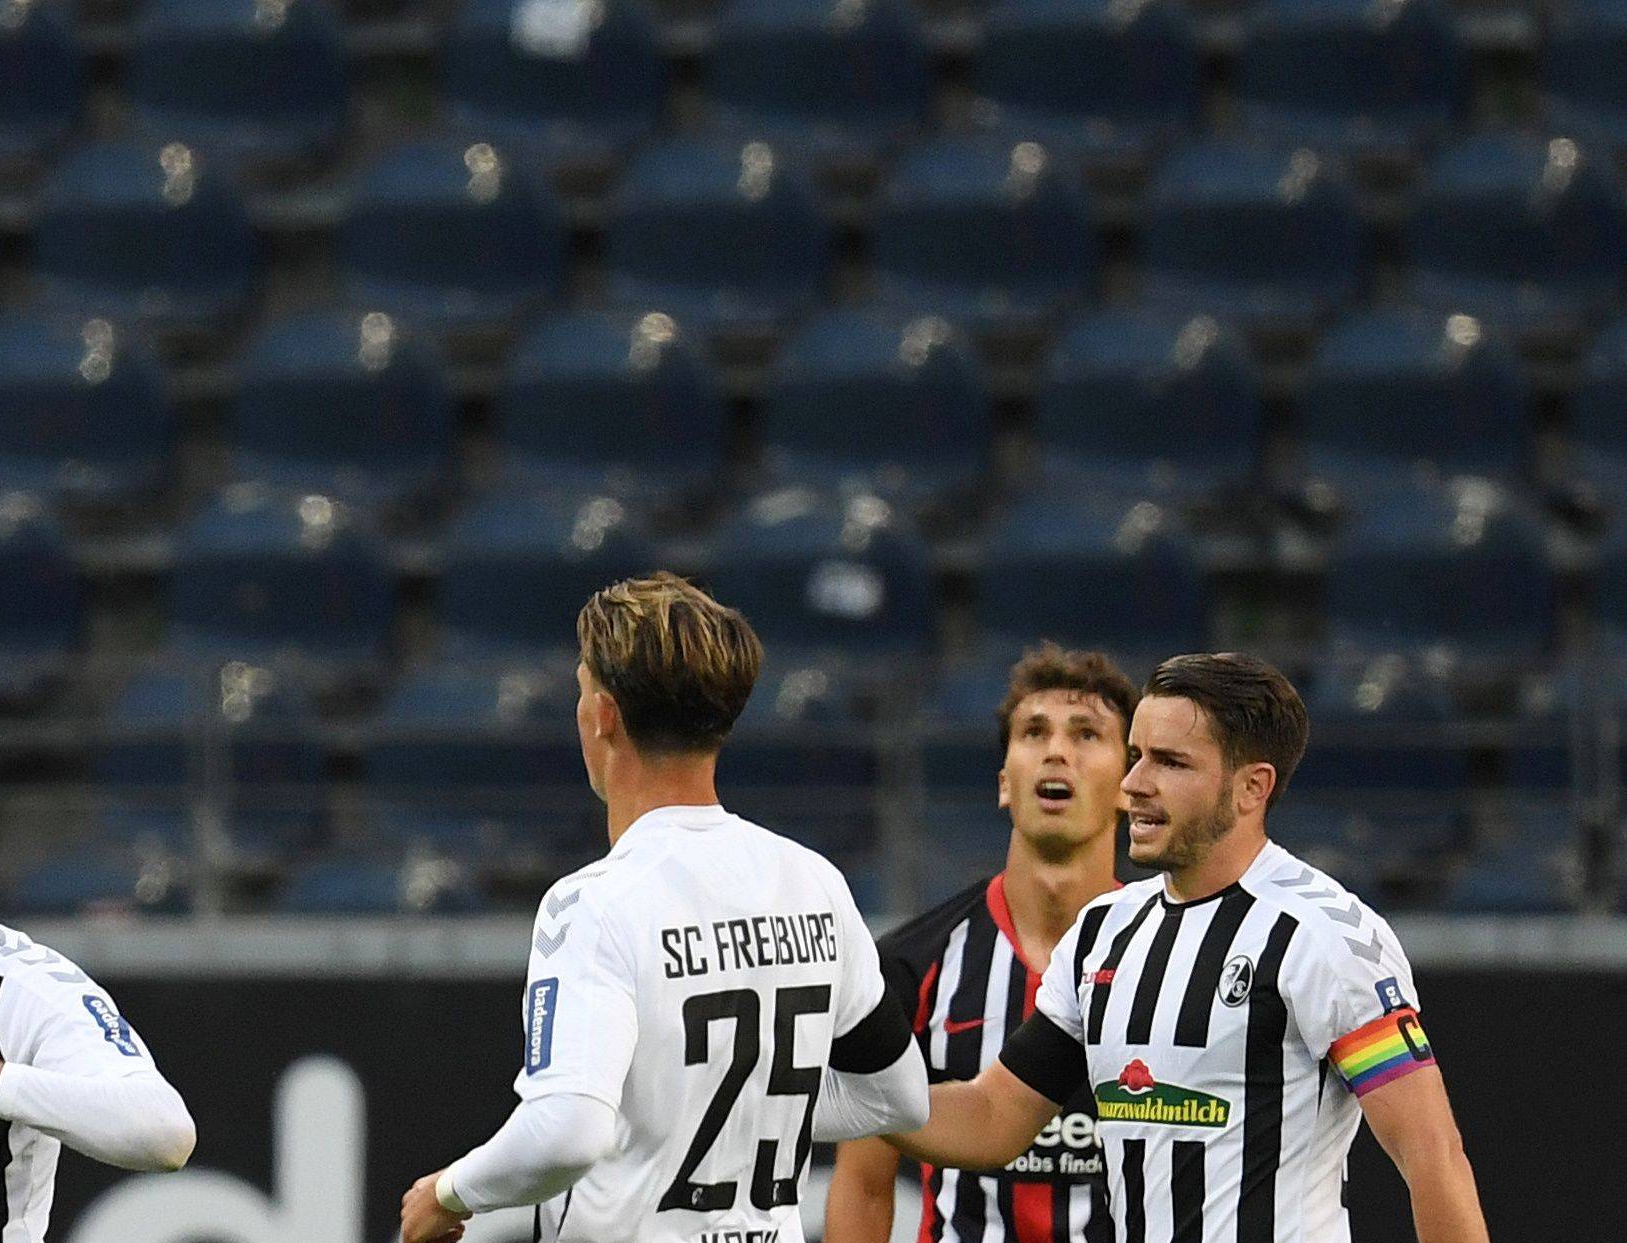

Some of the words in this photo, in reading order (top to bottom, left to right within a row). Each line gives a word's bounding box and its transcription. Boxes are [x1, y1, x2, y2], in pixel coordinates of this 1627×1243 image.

[661, 925, 709, 979] SC
[711, 911, 837, 971] FREIBURG
[530, 986, 551, 1067] badenova
[1396, 1015, 1433, 1062] C
[656, 984, 832, 1214] 25
[1004, 1150, 1054, 1173] obs
[1059, 1151, 1102, 1175] find
